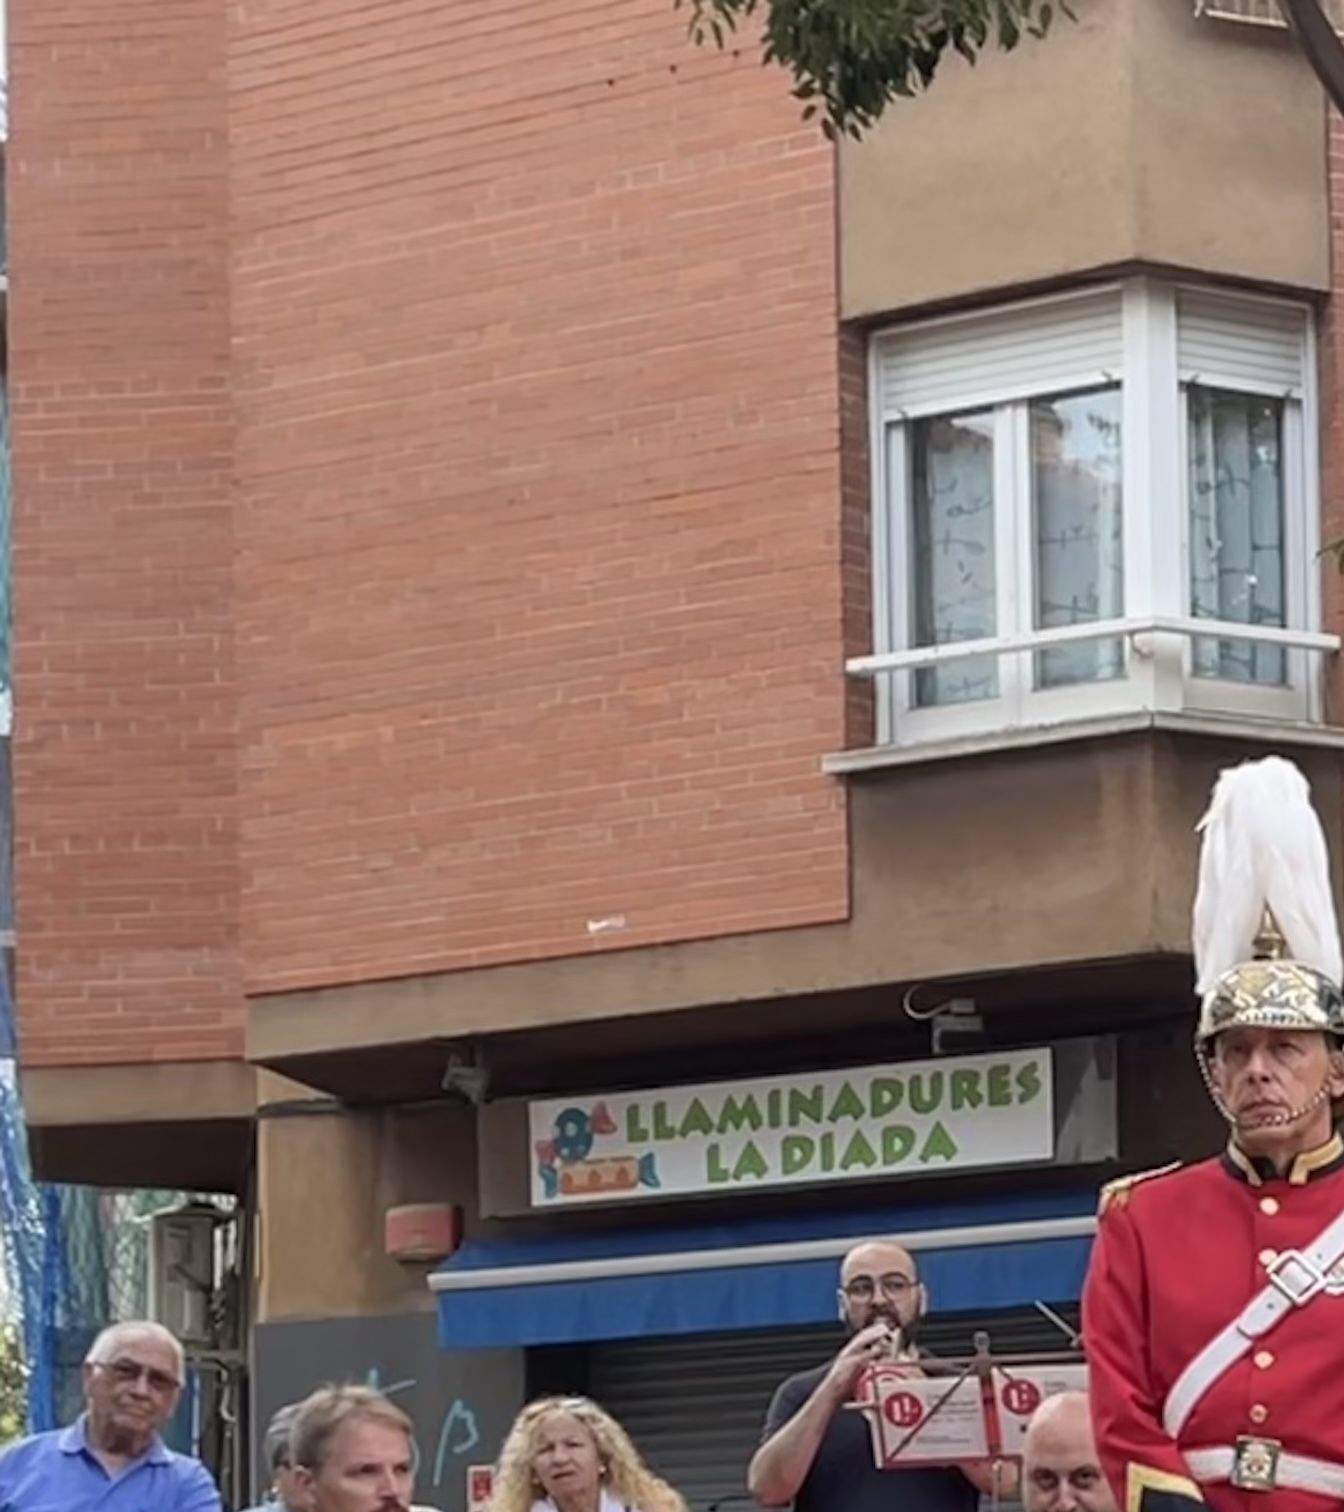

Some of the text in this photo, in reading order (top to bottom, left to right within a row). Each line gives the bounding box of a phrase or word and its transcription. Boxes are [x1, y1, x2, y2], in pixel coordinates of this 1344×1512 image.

[626, 1059, 1042, 1144] LLAMINADURES
[706, 1120, 959, 1183] LA DIADA
